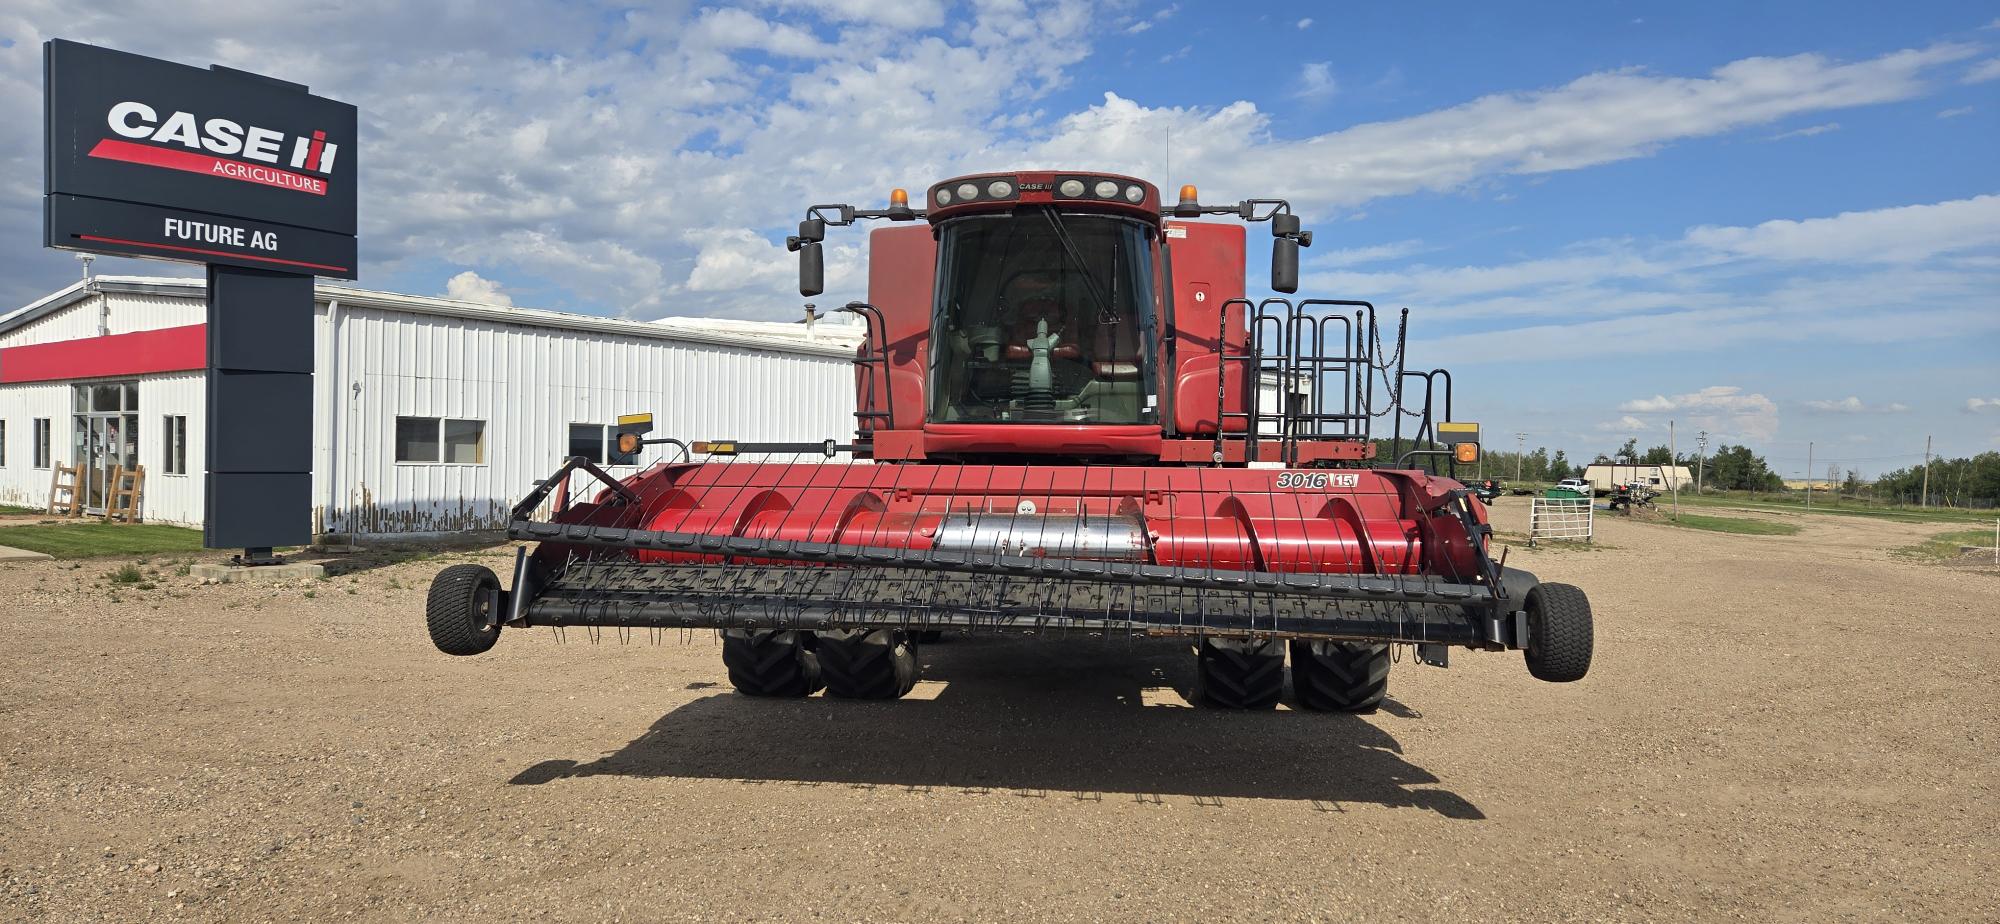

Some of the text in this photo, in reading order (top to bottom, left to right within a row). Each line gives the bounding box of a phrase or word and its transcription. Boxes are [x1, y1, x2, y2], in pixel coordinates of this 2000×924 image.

[107, 101, 338, 174] CASE IH
[212, 161, 321, 192] AGRICULTURE
[164, 218, 278, 252] FUTURE AG
[1277, 472, 1328, 488] 3016
